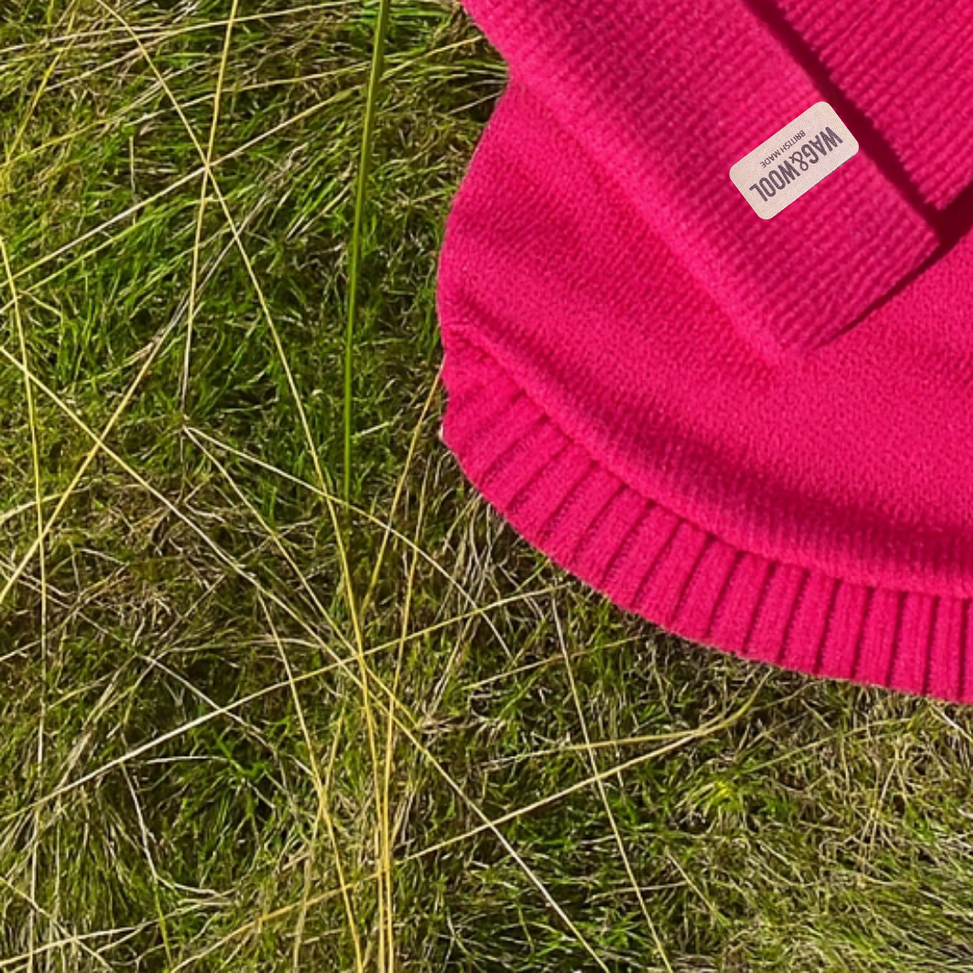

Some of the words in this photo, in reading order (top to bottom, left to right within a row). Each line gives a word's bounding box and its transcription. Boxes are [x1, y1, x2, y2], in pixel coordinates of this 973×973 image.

[780, 129, 806, 153] BRITISH
[748, 126, 844, 202] WAG&WOOL
[759, 150, 782, 169] MADE
